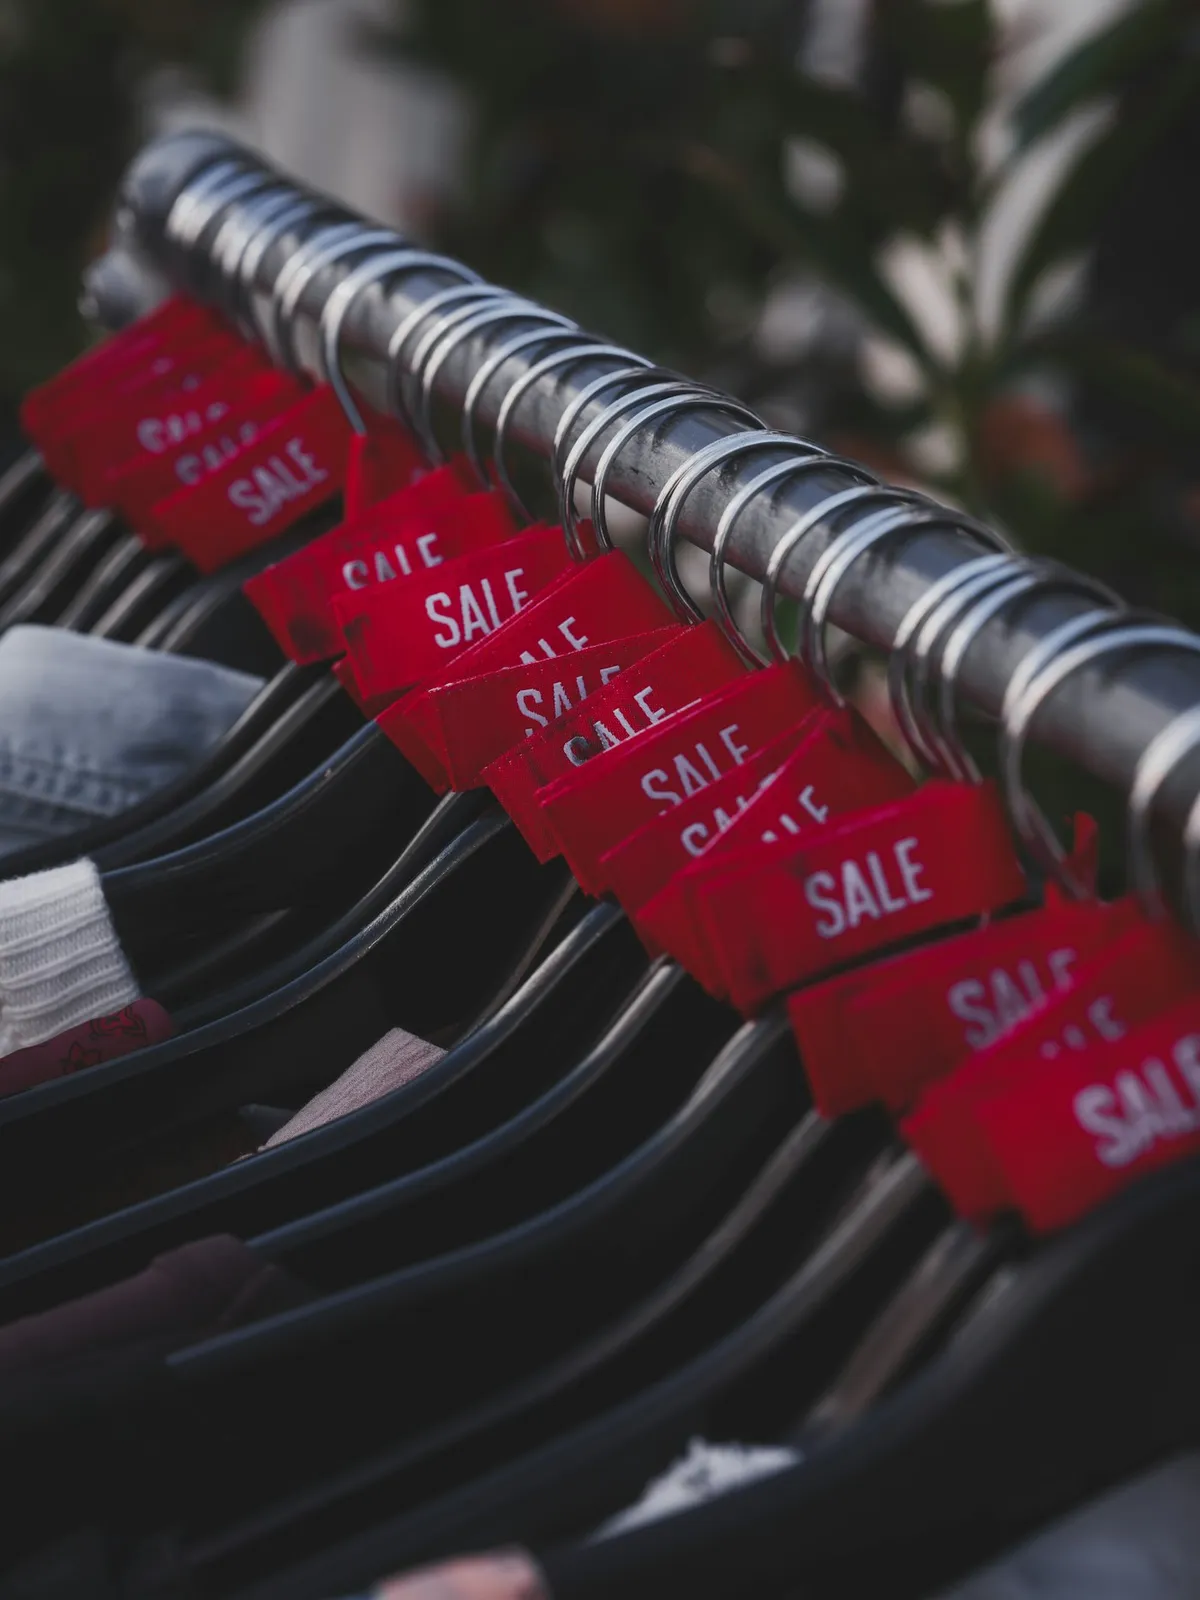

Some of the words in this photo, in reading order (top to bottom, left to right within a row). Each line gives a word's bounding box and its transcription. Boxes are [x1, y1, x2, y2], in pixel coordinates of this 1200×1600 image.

[227, 437, 328, 525] SALE
[425, 568, 530, 648] SALE
[641, 724, 749, 816] SALE
[805, 836, 932, 938] SALE
[948, 948, 1076, 1051] SALE
